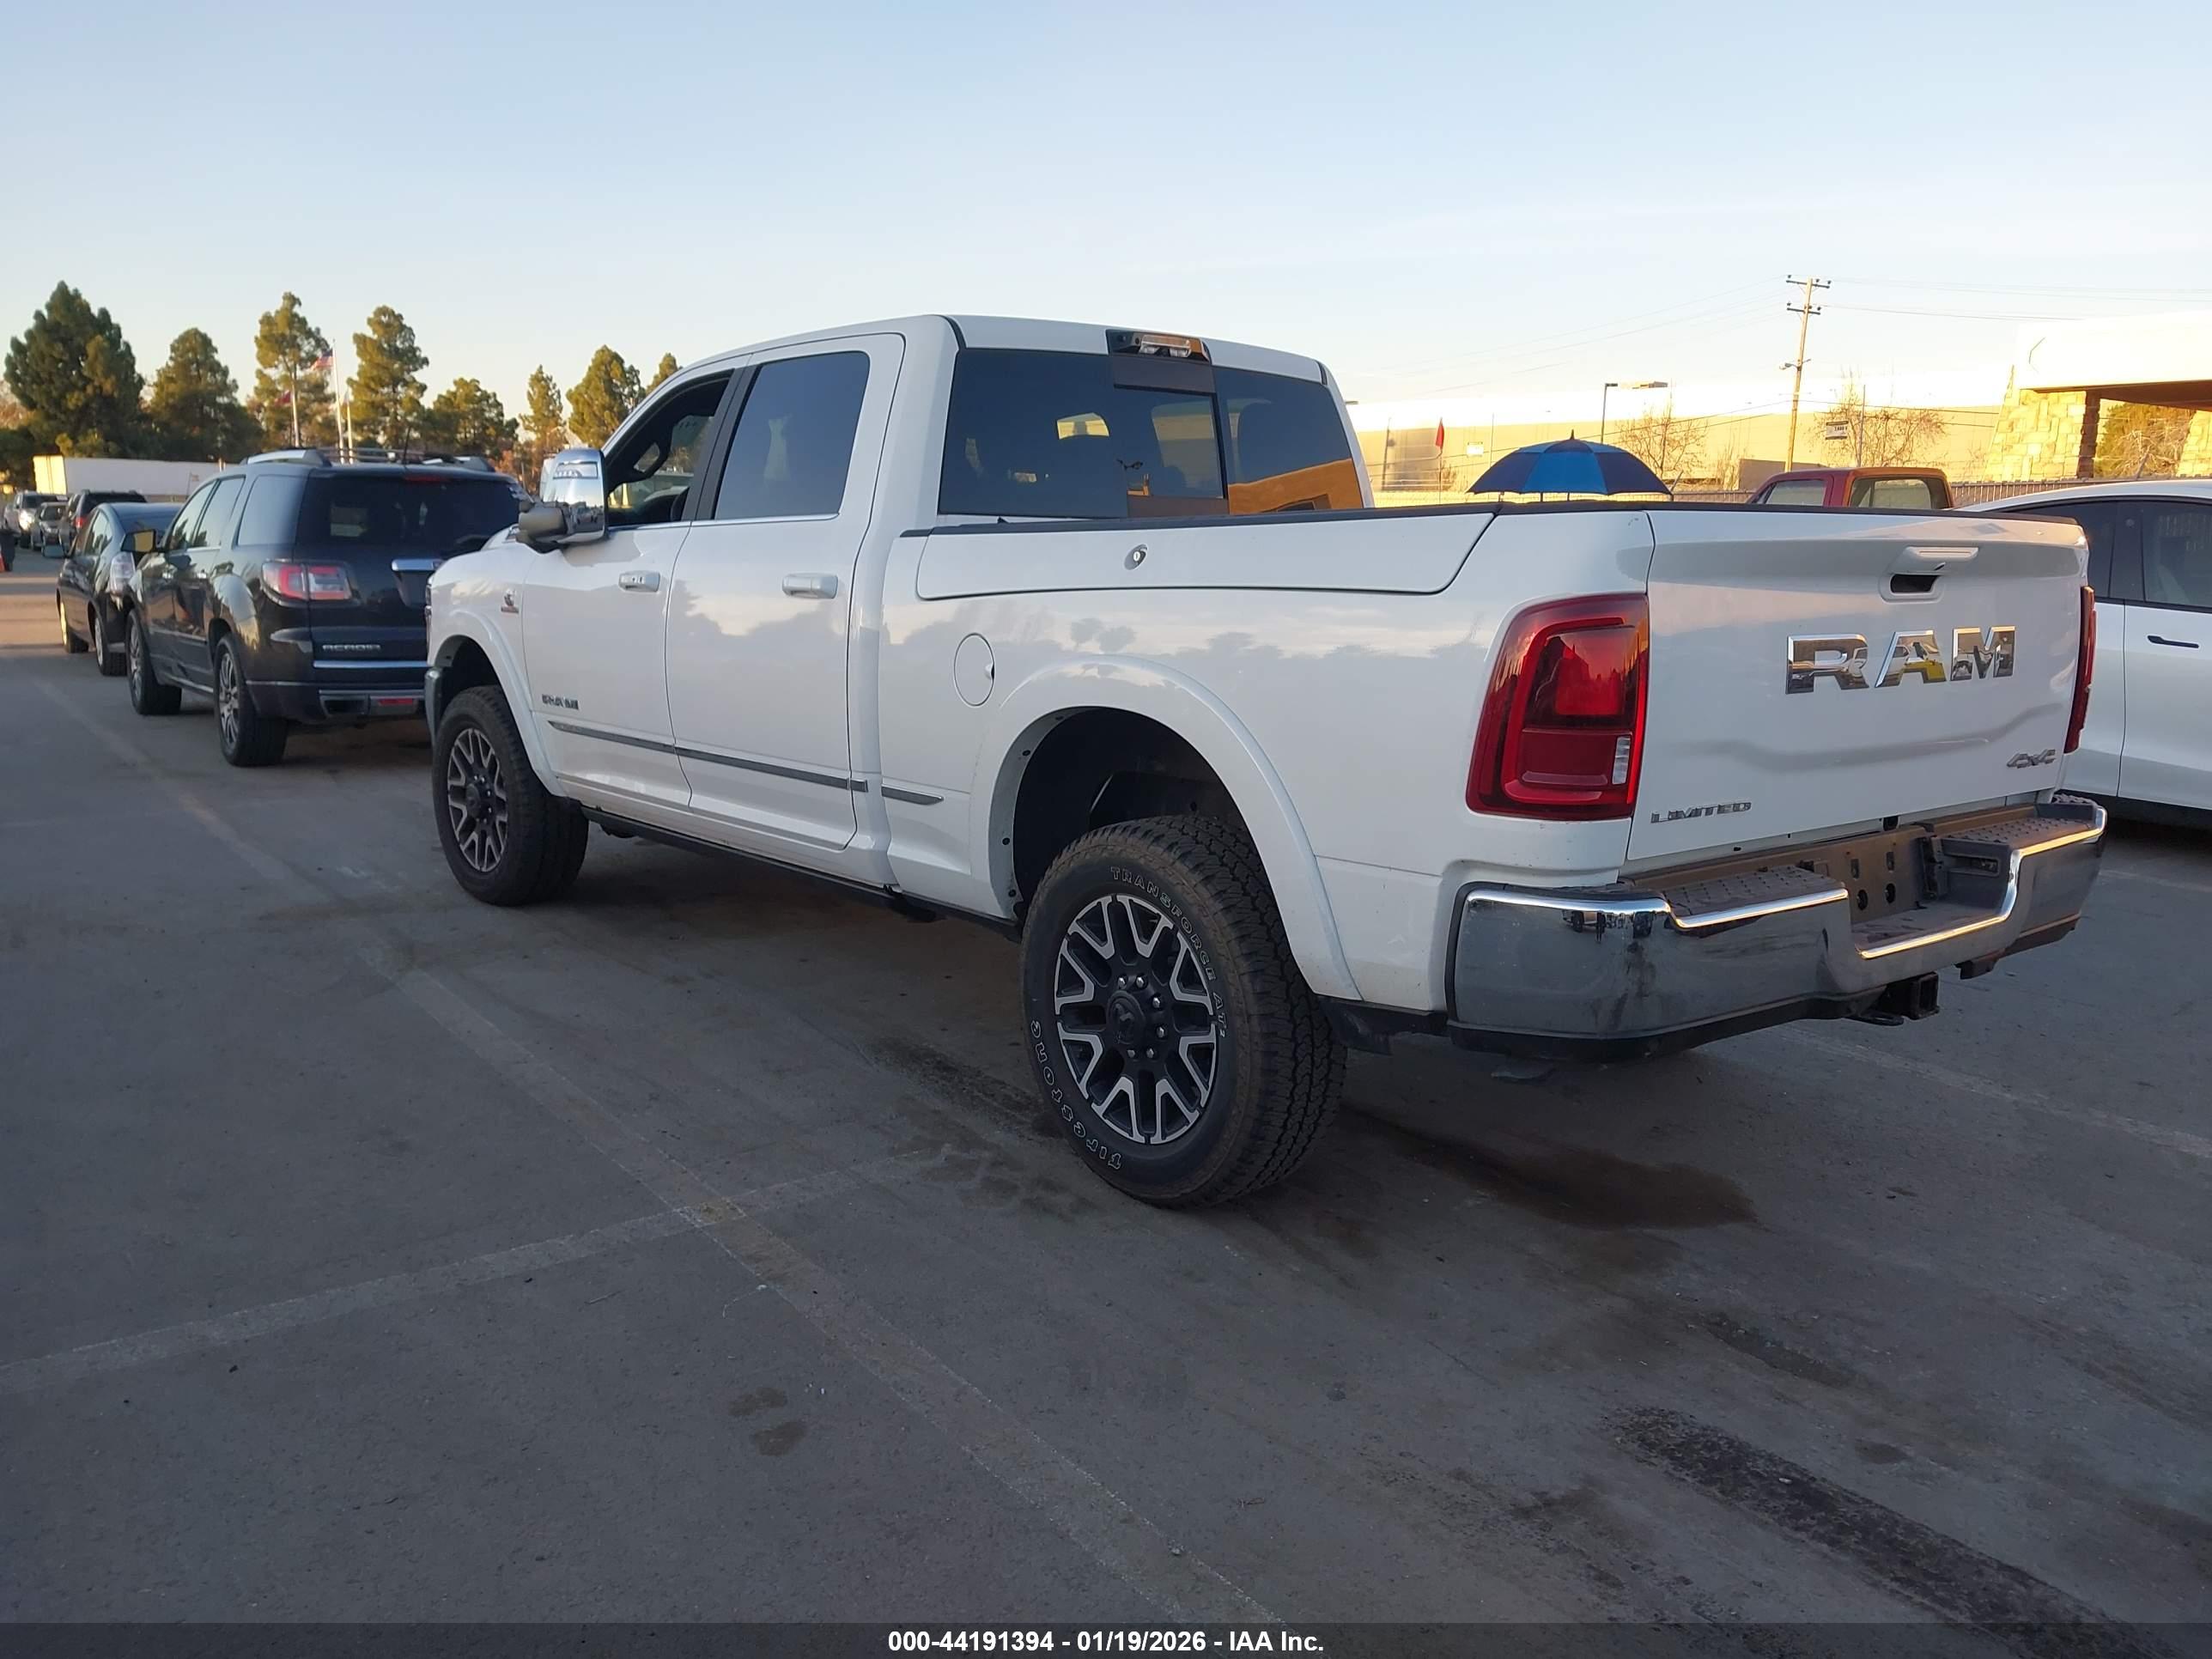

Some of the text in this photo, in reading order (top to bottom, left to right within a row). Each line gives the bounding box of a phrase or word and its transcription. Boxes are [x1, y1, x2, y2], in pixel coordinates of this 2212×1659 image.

[1784, 625, 2017, 695] RAM
[1650, 802, 1752, 823] LIMITED
[1110, 866, 1217, 981] TRANSFORCE
